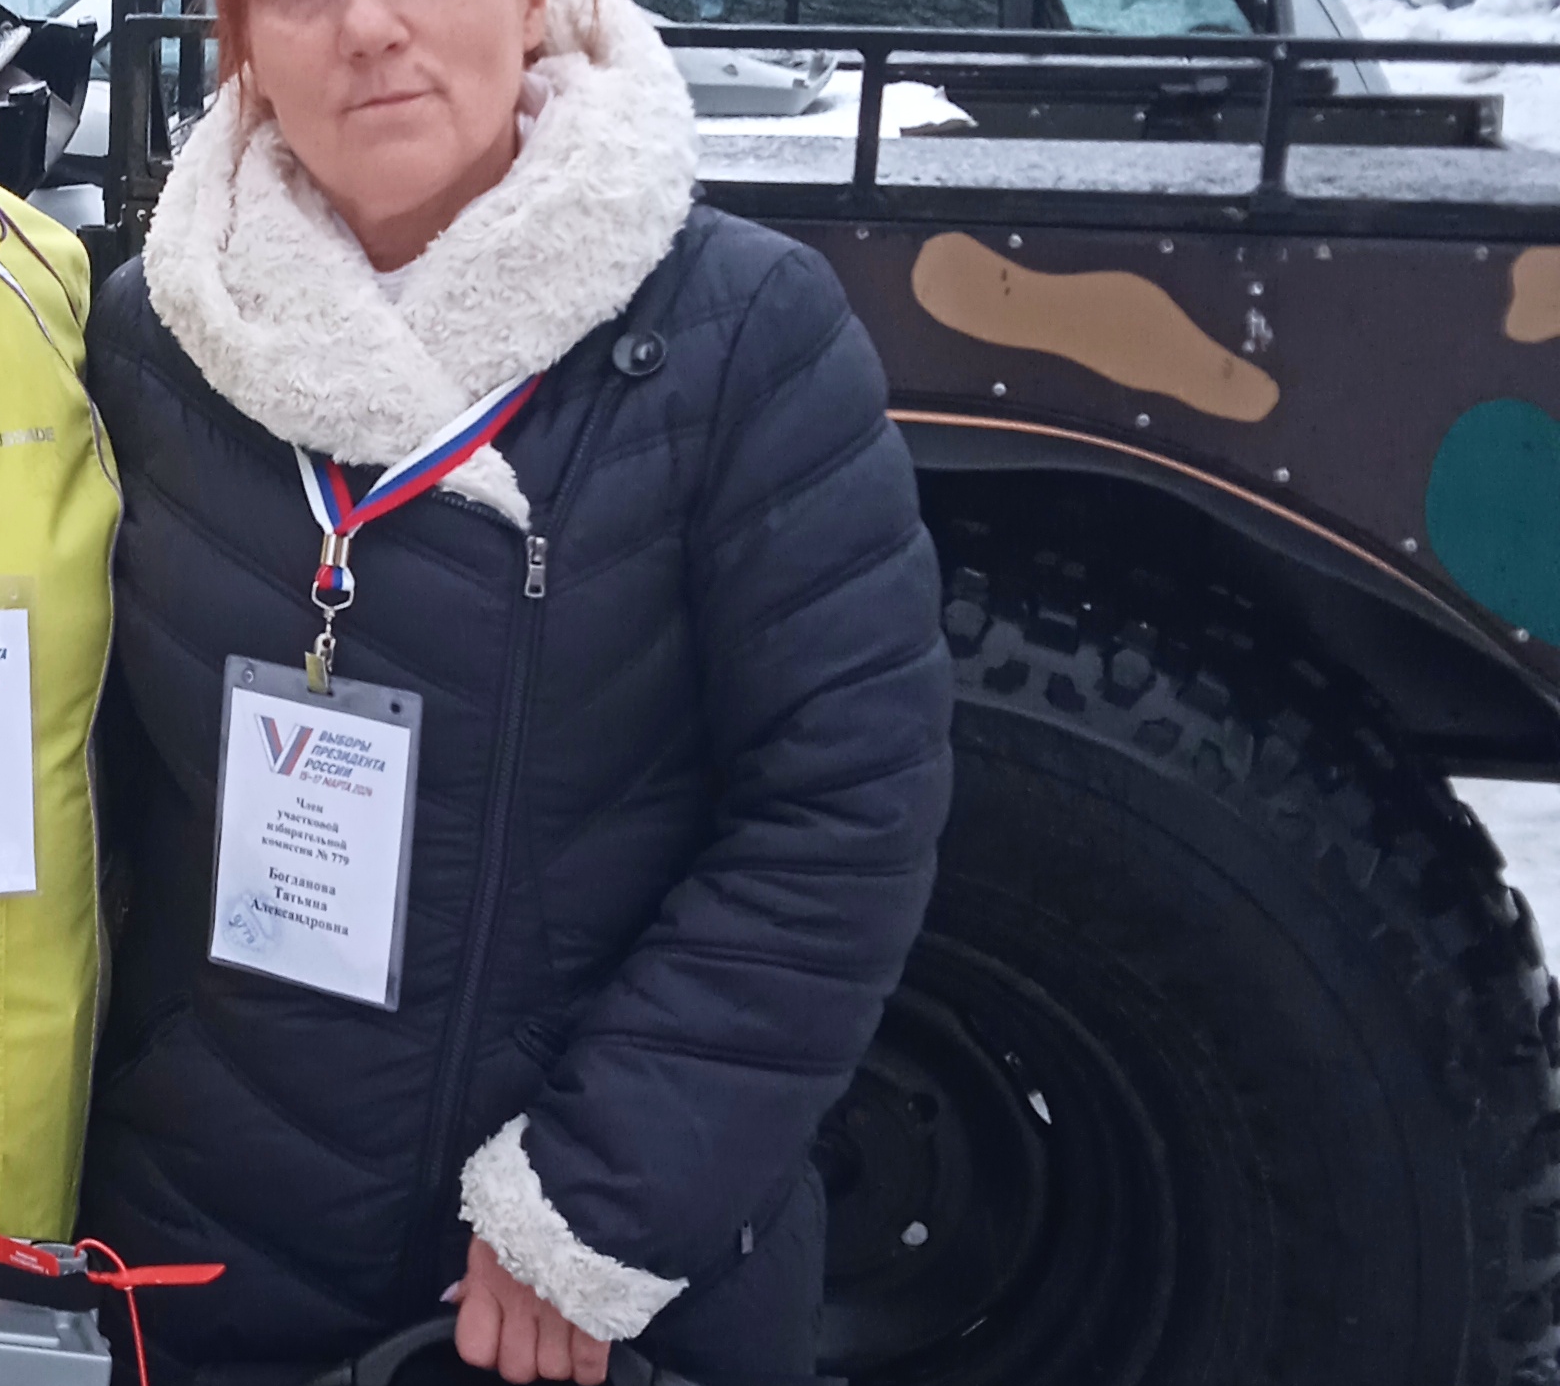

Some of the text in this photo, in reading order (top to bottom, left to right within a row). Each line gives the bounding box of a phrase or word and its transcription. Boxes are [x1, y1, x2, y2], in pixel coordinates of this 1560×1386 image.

[318, 730, 372, 752] ВЫБОРЫ
[304, 758, 354, 778] РОССИИ
[311, 744, 386, 772] ПРЕЗИДЕНТА
[322, 776, 351, 792] МАРТА
[296, 797, 324, 813] Член
[277, 809, 339, 833] участковой
[266, 822, 347, 851] избирательной
[261, 836, 313, 857] комиссии
[331, 852, 350, 865] 779
[269, 866, 336, 896] Богданова
[274, 885, 328, 912] Татьяна
[251, 898, 349, 936] Александровна
